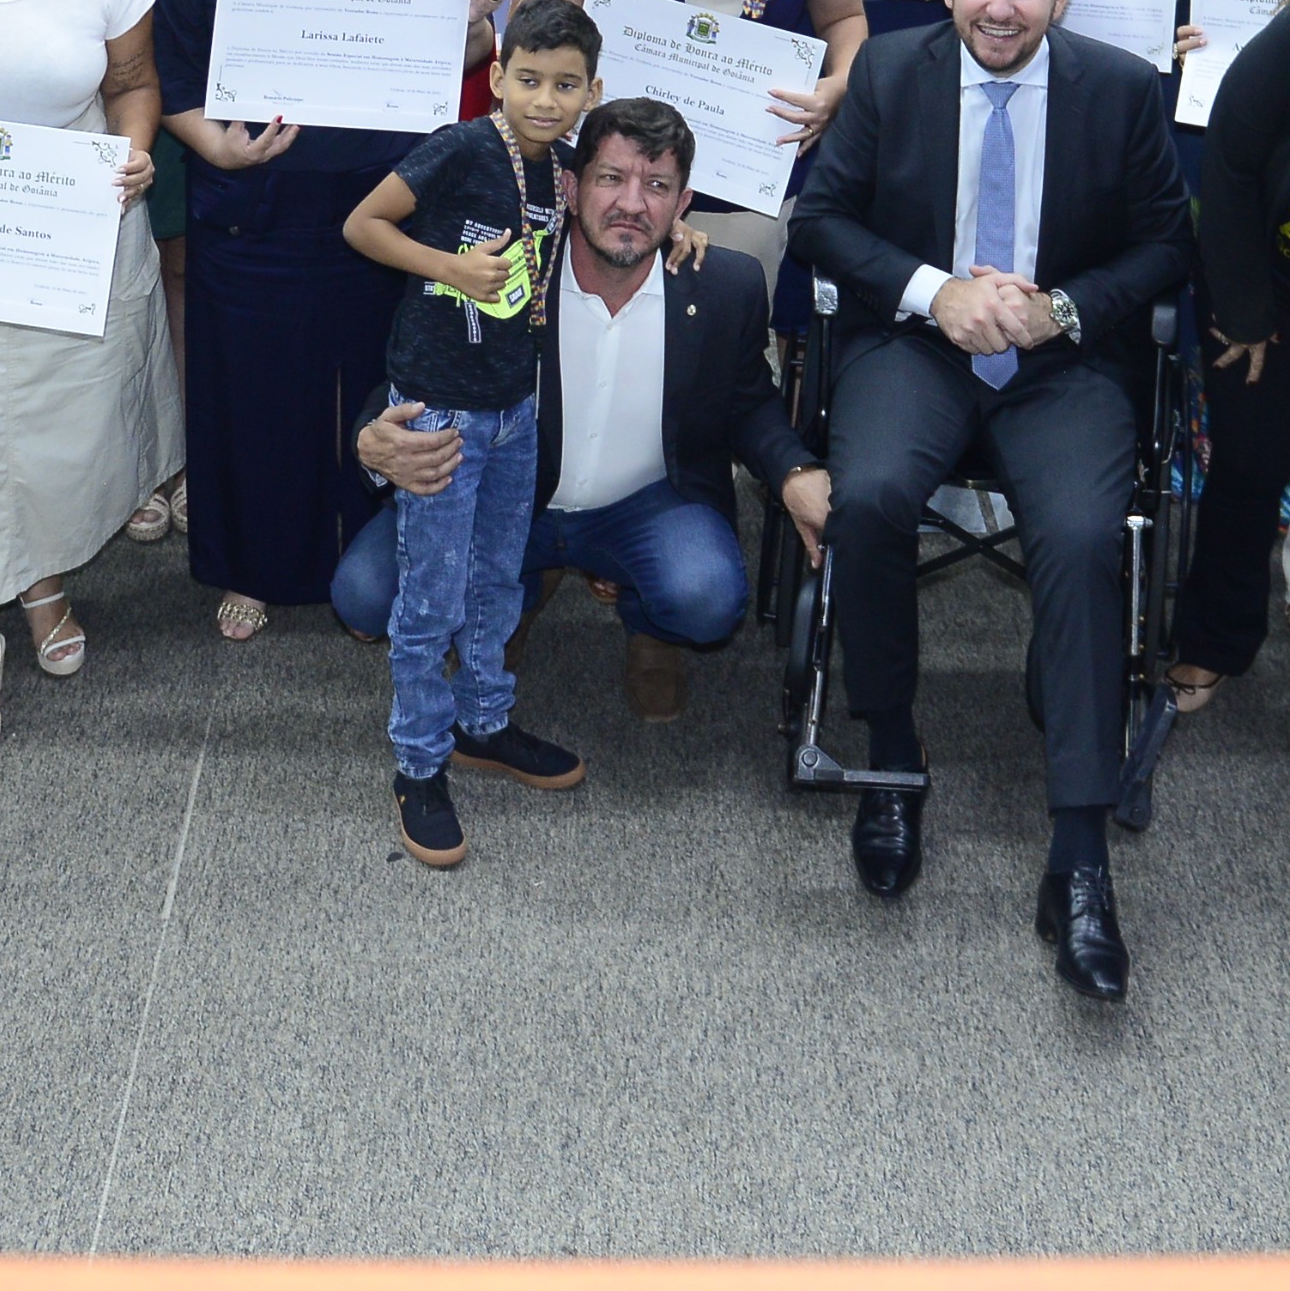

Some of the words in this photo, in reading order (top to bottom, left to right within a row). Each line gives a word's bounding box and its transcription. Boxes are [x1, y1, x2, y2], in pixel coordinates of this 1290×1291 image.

[301, 30, 339, 42] Larissa
[342, 32, 385, 45] Lafaiete
[623, 26, 667, 46] Diploma
[670, 38, 681, 50] de
[685, 43, 714, 60] Honra
[721, 54, 733, 64] ao
[735, 58, 773, 76] Mérito
[635, 44, 666, 58] Câmara
[668, 53, 709, 71] Municipal
[711, 64, 719, 74] de
[645, 85, 681, 104] Chirley
[683, 96, 695, 106] de
[699, 101, 725, 116] Paula
[9, 182, 19, 192] de
[19, 170, 31, 180] ao
[35, 170, 75, 187] Mérito
[0, 224, 12, 235] de
[15, 226, 52, 240] Santos
